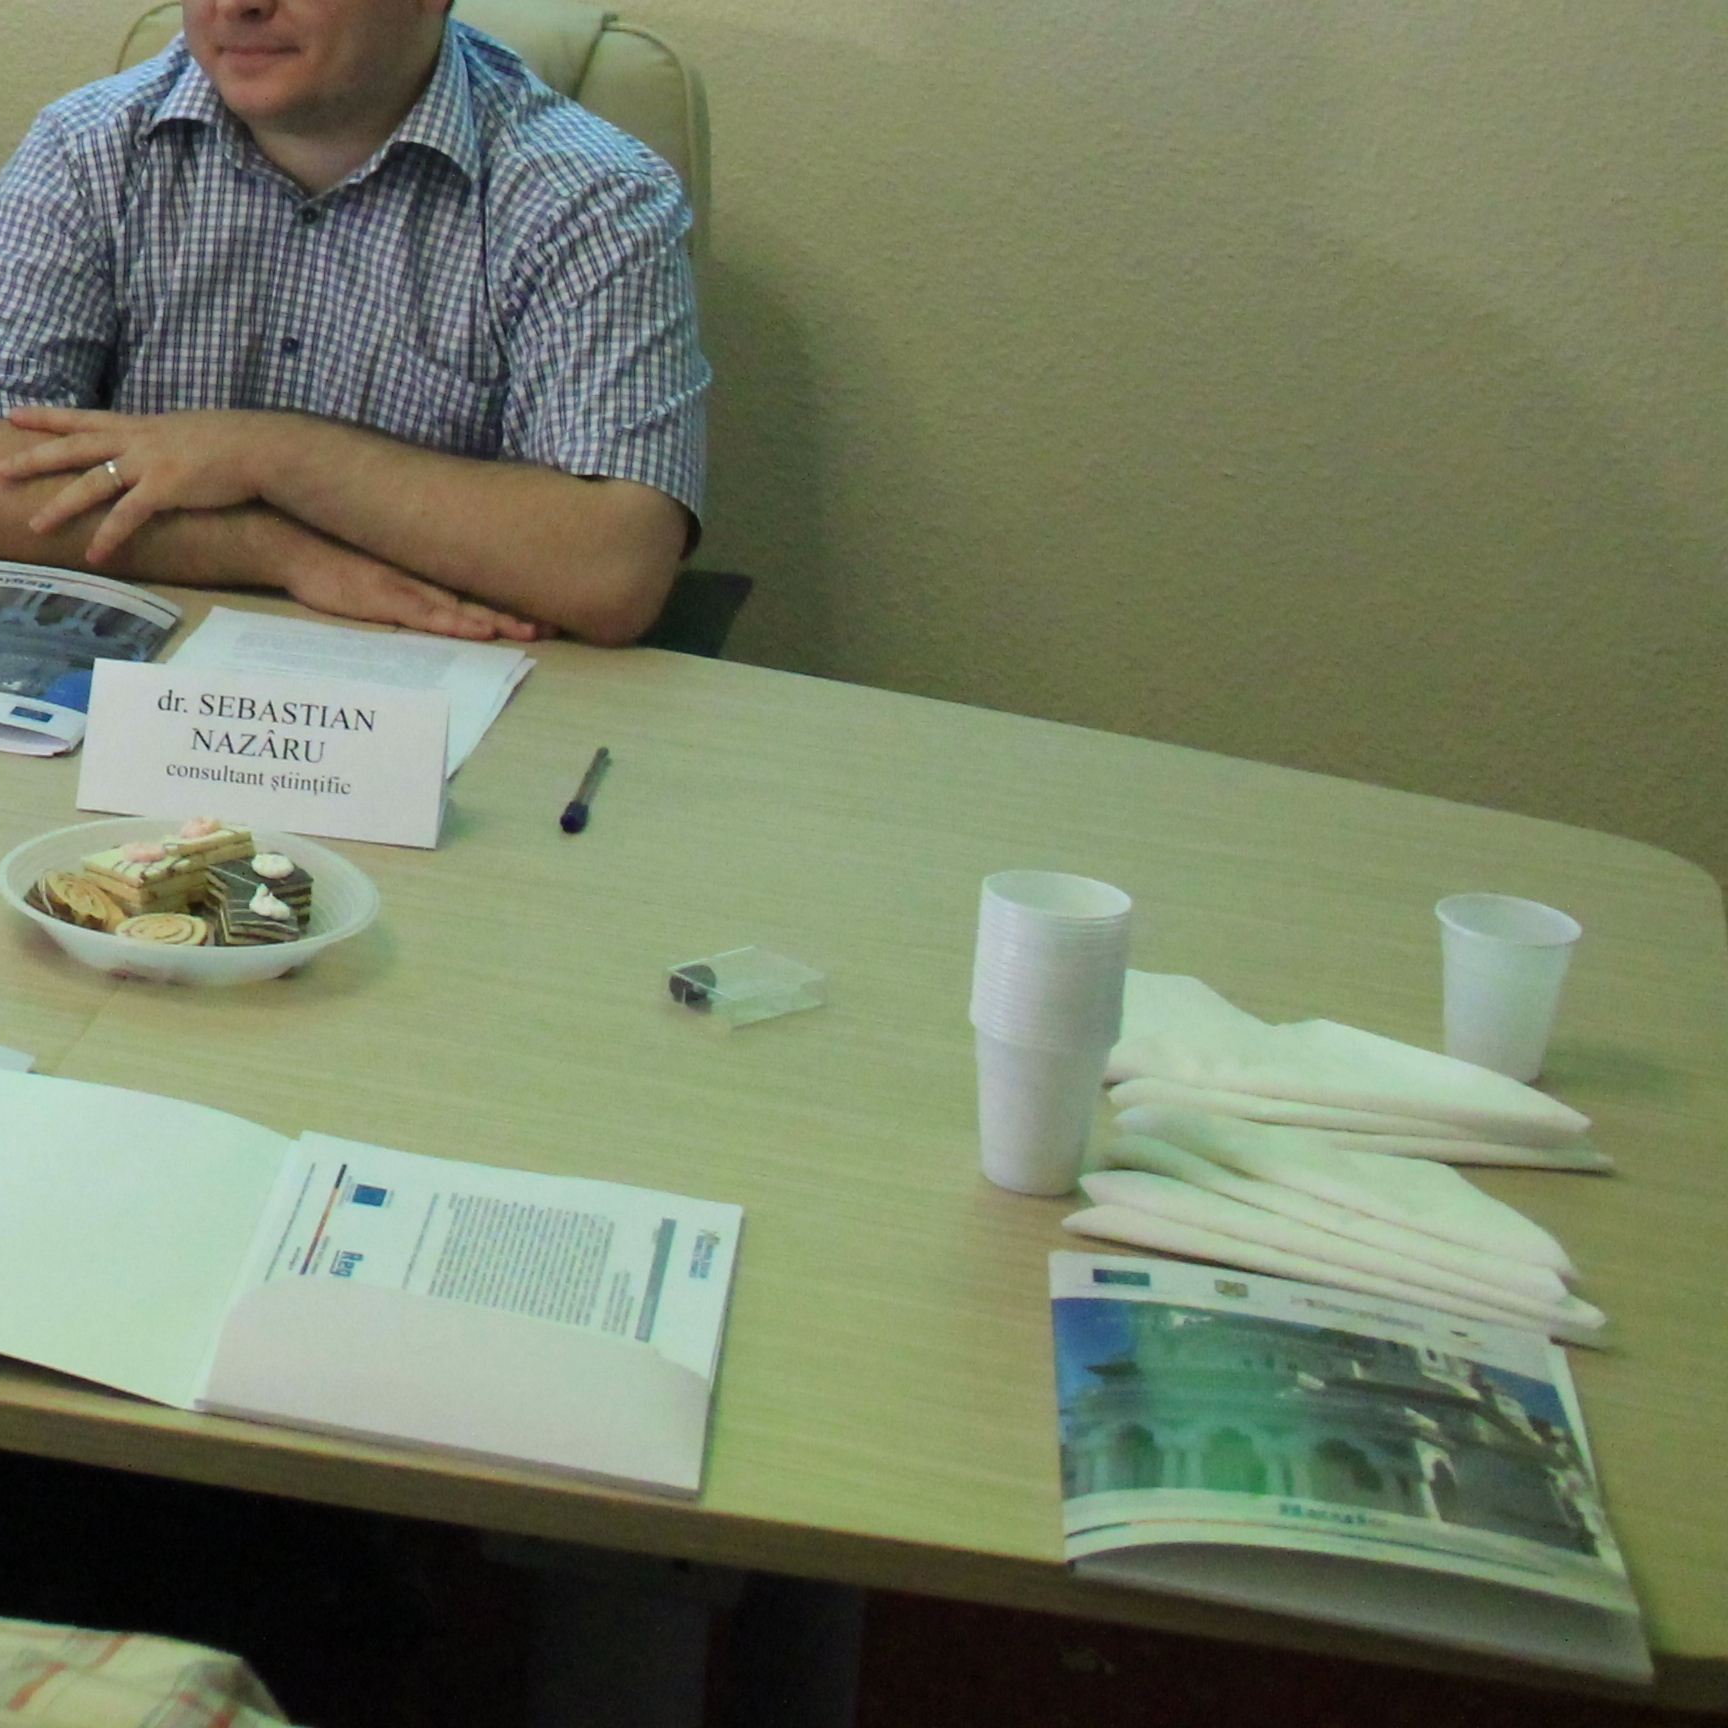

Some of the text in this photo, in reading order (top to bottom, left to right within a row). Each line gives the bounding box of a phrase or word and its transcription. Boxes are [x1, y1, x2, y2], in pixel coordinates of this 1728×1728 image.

[157, 689, 377, 732] dr. SEBASTIAN
[191, 728, 326, 763] NAZÂRU
[166, 763, 352, 797] consultant științific
